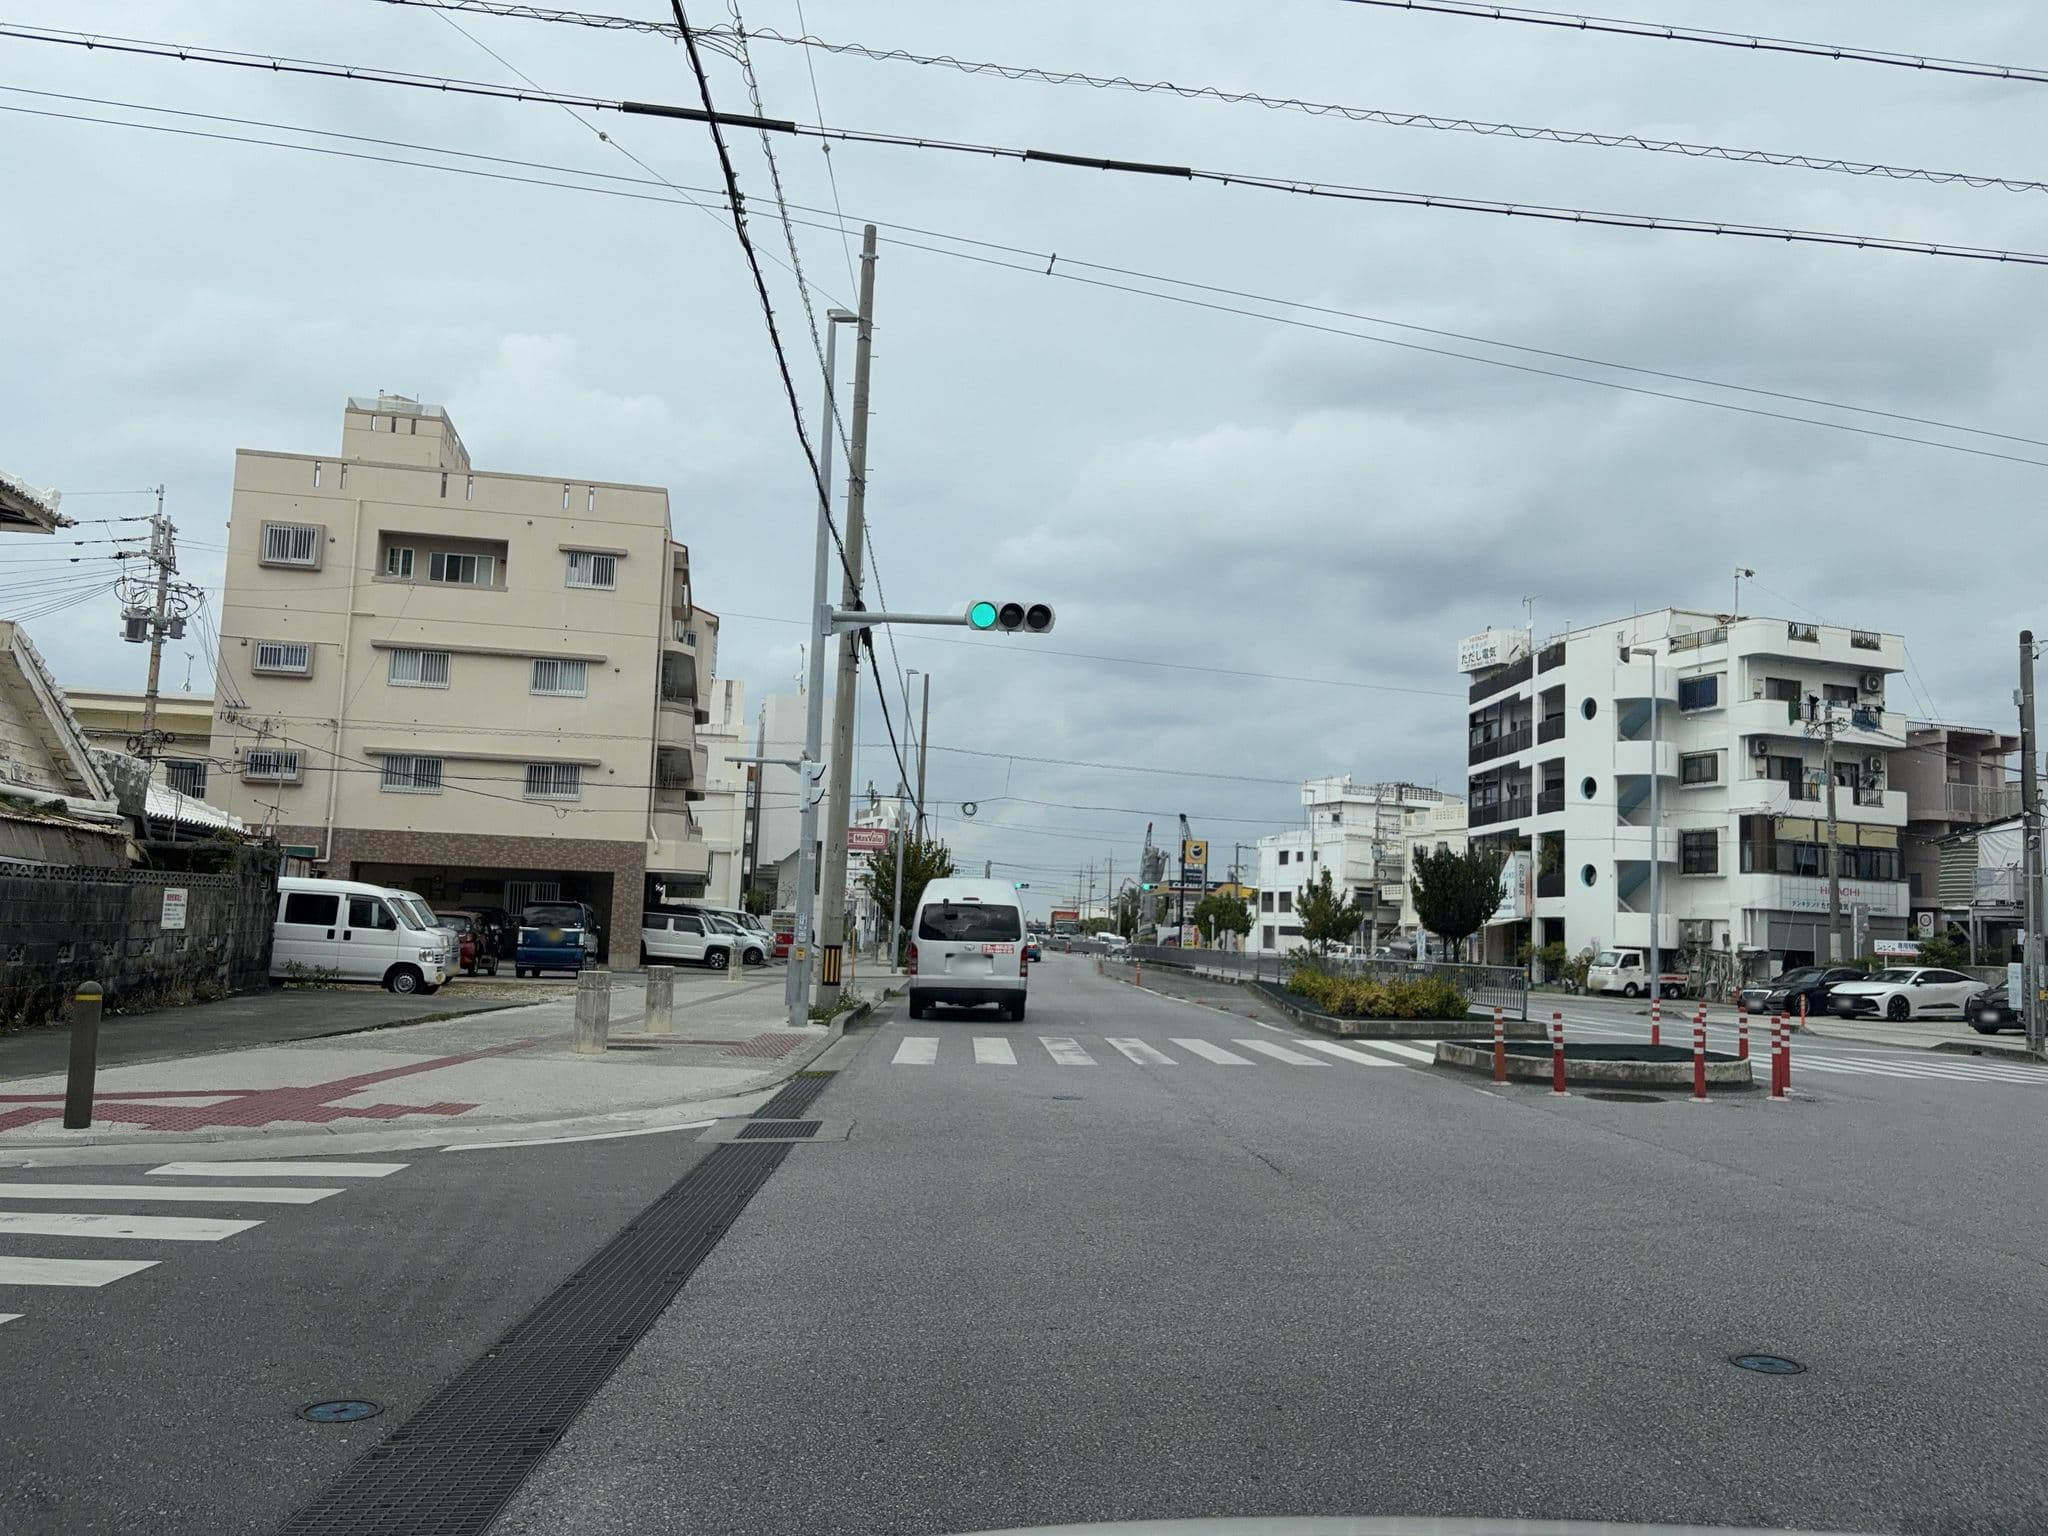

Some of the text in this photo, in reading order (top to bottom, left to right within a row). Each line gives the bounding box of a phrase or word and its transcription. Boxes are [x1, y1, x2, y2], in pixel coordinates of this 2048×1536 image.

[1461, 646, 1497, 665] ただし電気
[1819, 886, 1860, 898] HIACHI
